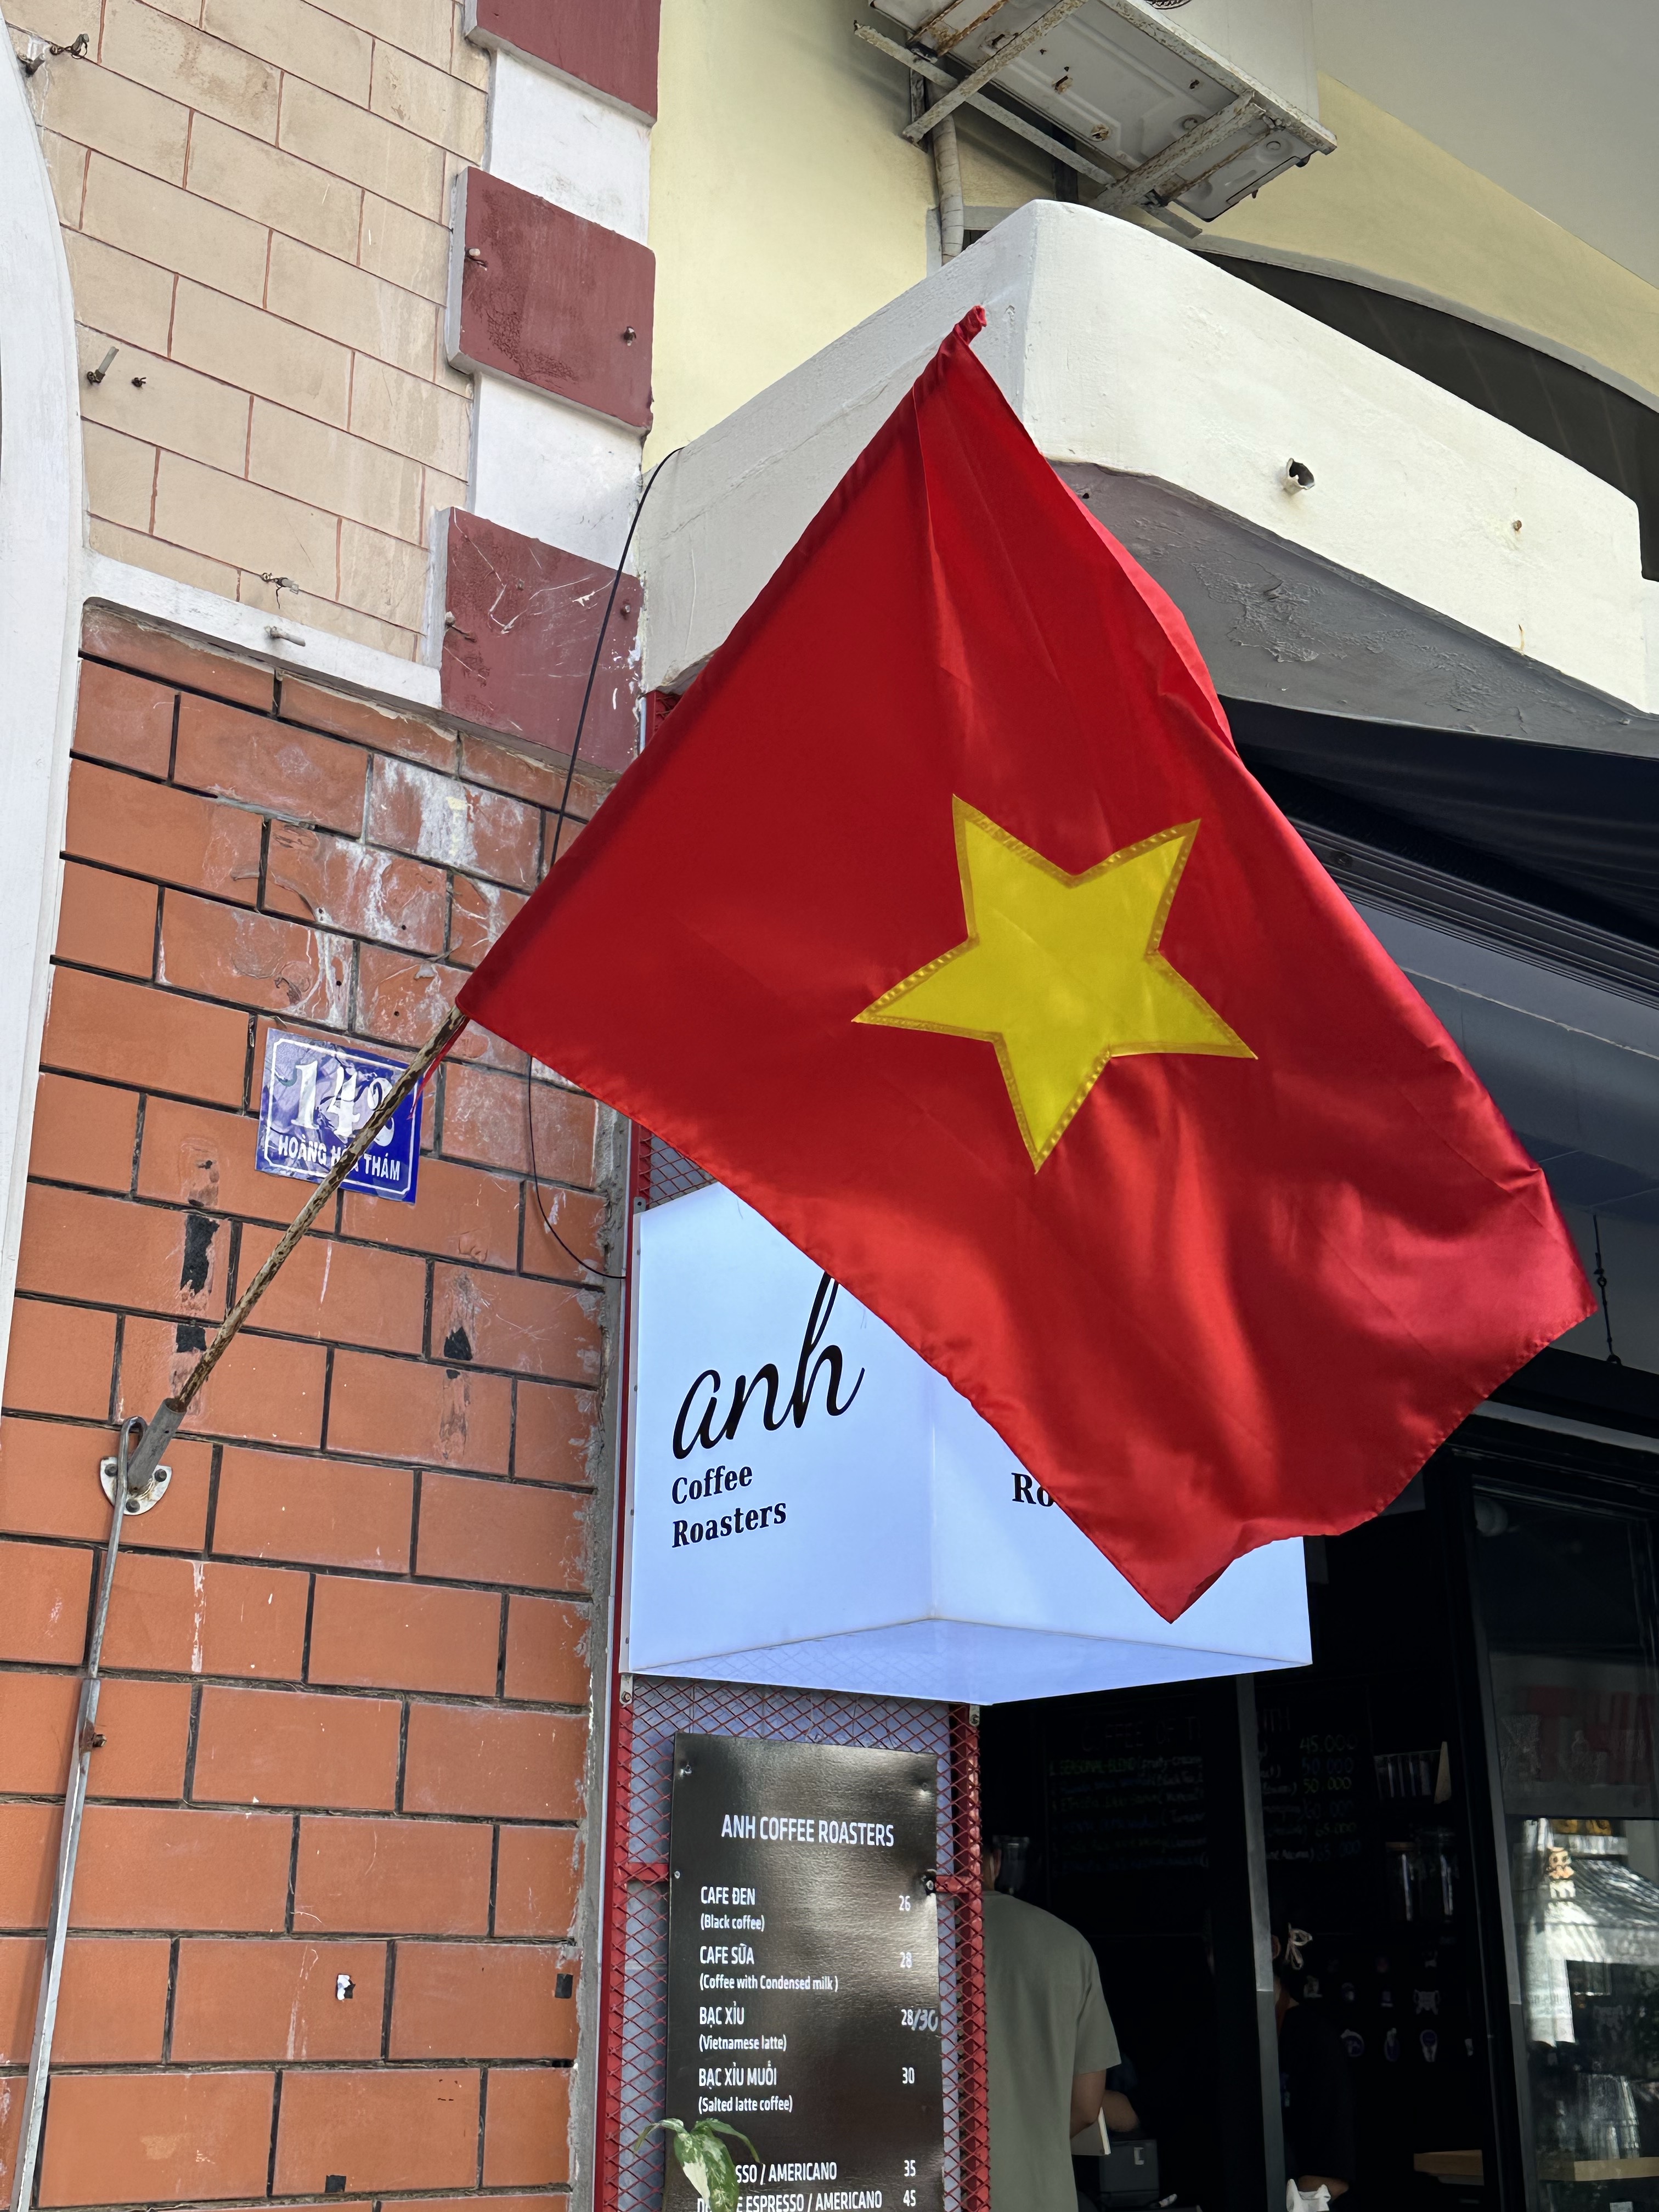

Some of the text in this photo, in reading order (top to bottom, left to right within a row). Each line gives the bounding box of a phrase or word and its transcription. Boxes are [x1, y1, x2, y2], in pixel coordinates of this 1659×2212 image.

[278, 1134, 327, 1165] HOÀNG
[364, 1153, 400, 1181] THÁM
[673, 1271, 865, 1459] anh
[672, 1465, 752, 1505] Coffee
[672, 1501, 787, 1548] Roasters
[1299, 1734, 1358, 1754] 45.000
[721, 1814, 894, 1847] ANH COFFEE ROASTERS
[701, 1886, 911, 1911] CAFE ĐEN 26
[701, 1913, 765, 1932] (Black coffee)
[700, 1946, 728, 1964] CAFE
[899, 1951, 913, 1968] 28
[699, 1973, 735, 1991] (Coffee
[736, 1974, 758, 1989] with
[760, 1975, 811, 1990] Condensed
[699, 2006, 722, 2028] BẠC
[725, 2001, 744, 2024] XỈU
[699, 2034, 787, 2052] (Vietnamese latte)
[698, 2068, 722, 2090] BẠC
[724, 2062, 744, 2085] XỈU
[902, 2067, 915, 2084] 30
[698, 2095, 793, 2114] (Salted latte coffee)
[768, 2162, 837, 2182] AMERICANO
[904, 2160, 916, 2177] 35
[746, 2193, 804, 2212] ESPRESSO
[815, 2191, 882, 2211] AMERICANO
[903, 2190, 916, 2207] 45
